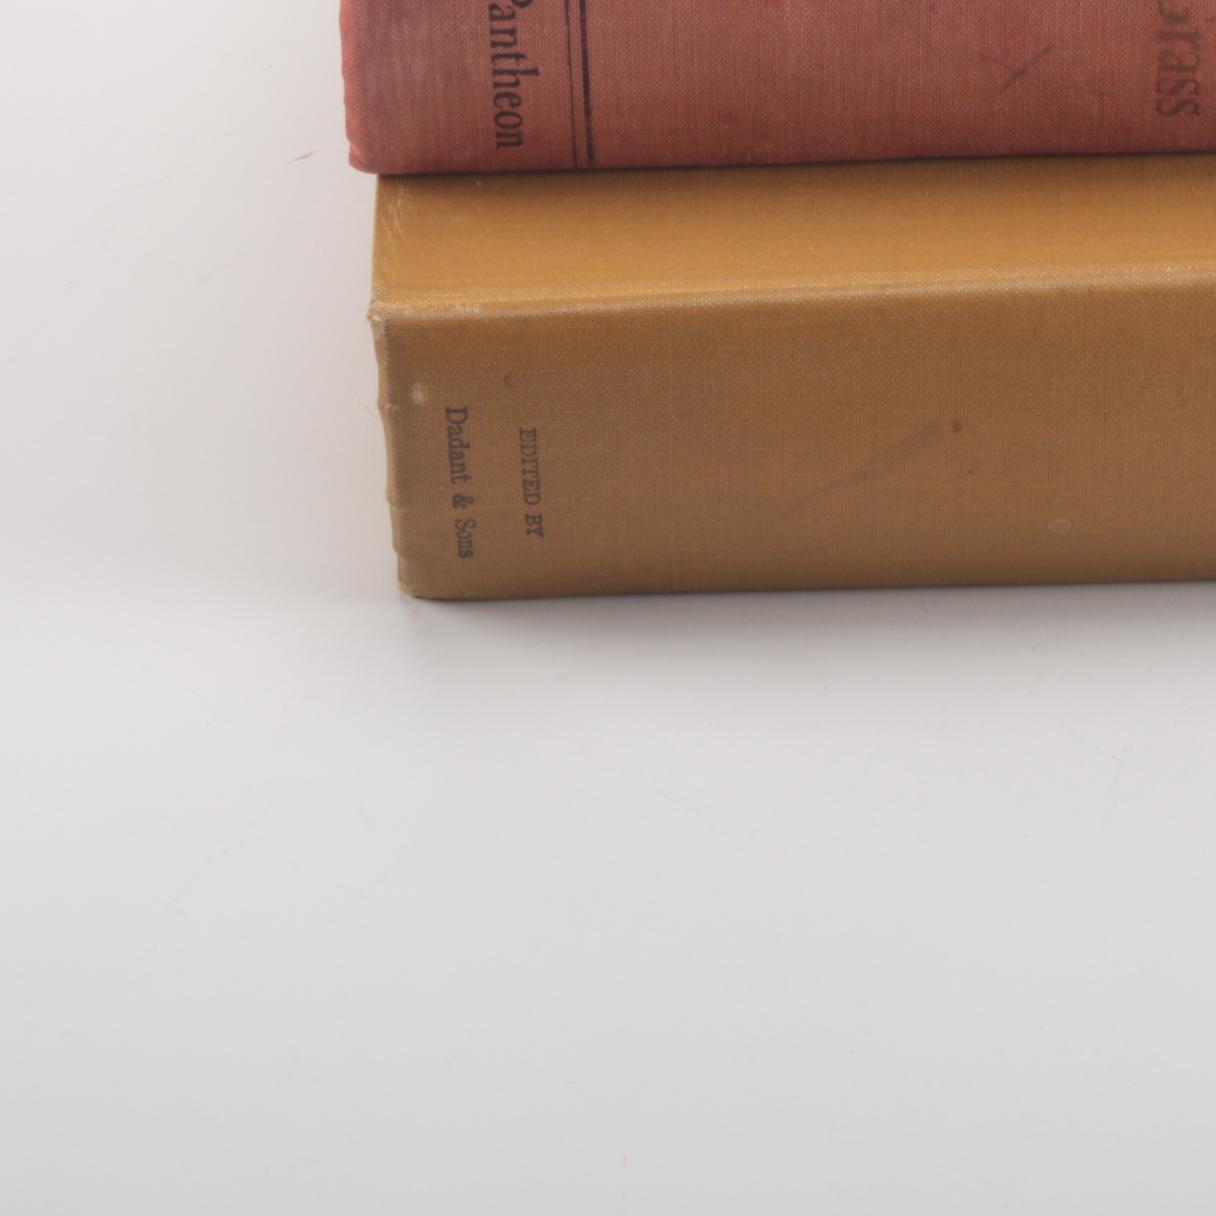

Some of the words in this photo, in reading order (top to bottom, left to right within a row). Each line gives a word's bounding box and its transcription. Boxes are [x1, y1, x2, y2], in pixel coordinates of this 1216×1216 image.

[446, 405, 472, 485] Dadant
[518, 427, 542, 506] EDITED
[452, 492, 475, 510] &
[455, 518, 477, 559] Sons
[524, 513, 545, 539] BY
